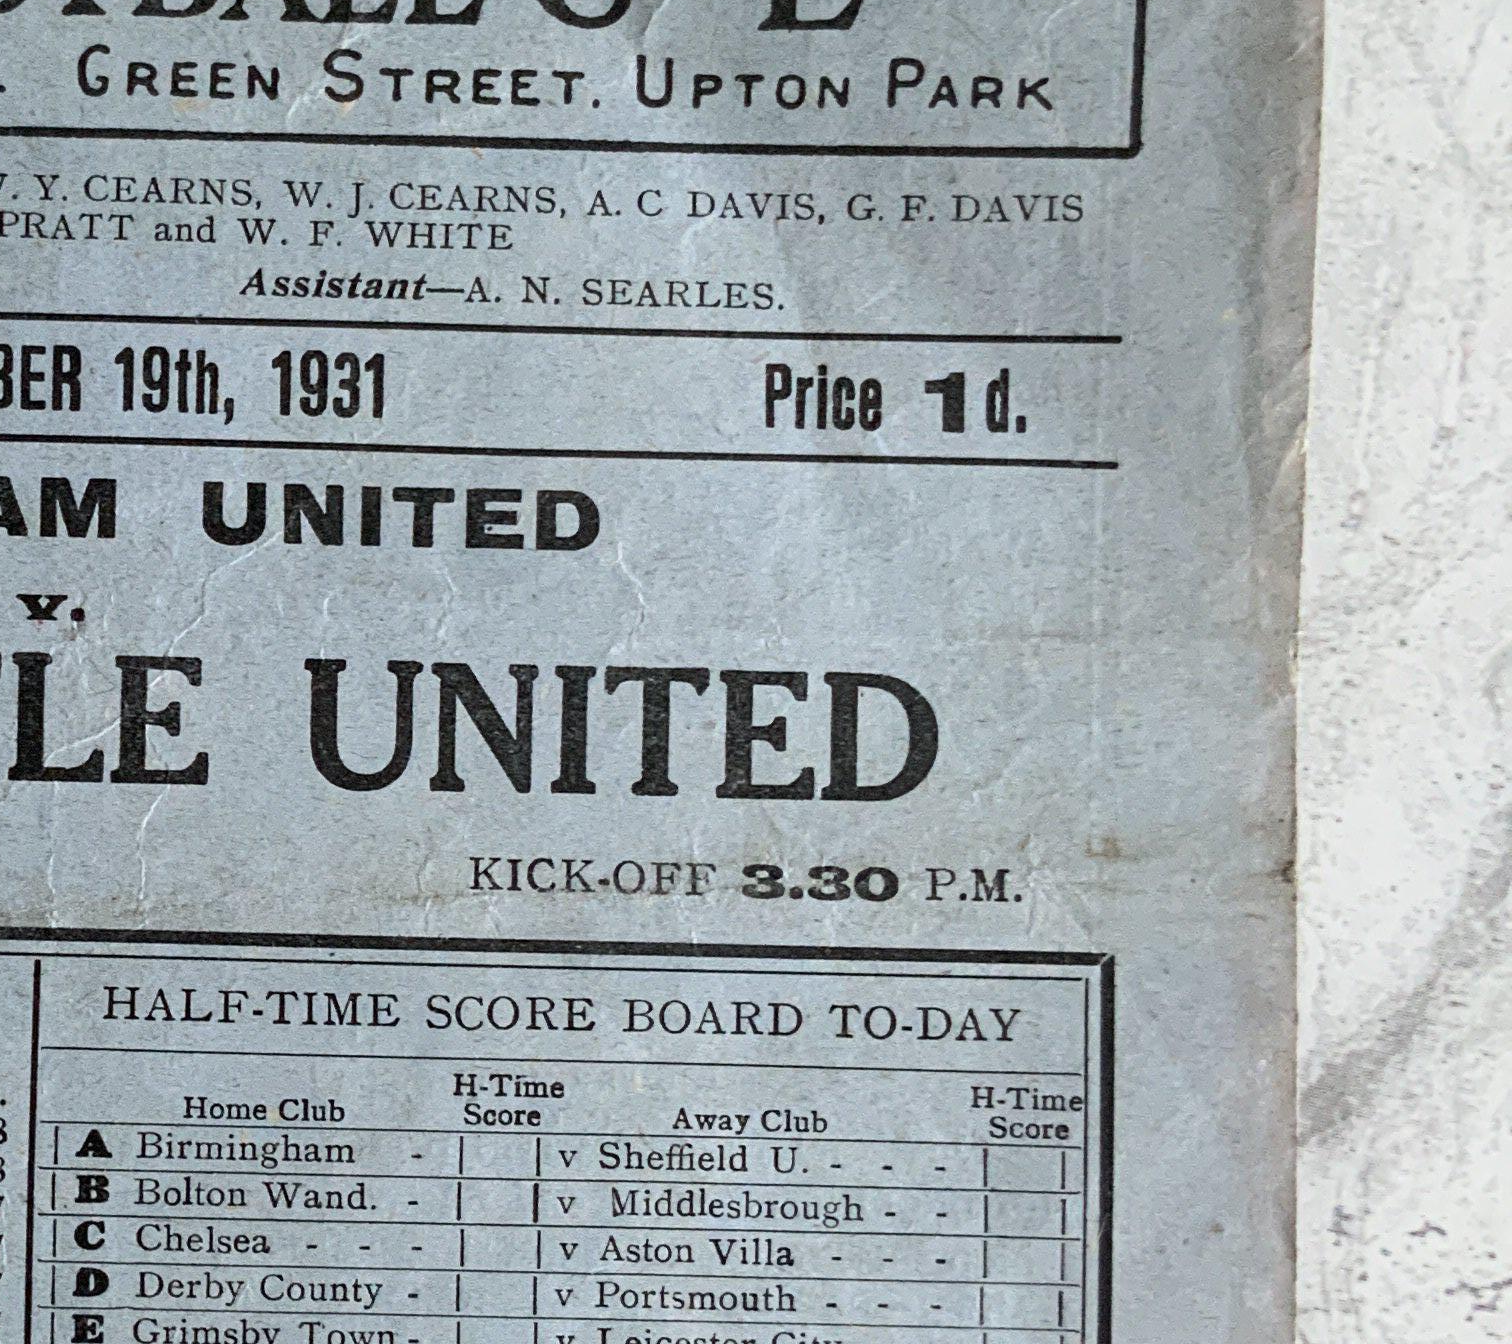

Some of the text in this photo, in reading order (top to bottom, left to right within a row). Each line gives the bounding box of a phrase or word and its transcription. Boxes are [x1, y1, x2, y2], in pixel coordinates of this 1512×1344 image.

[32, 173, 68, 202] Y.
[83, 174, 262, 211] CEARNS,
[282, 179, 333, 209] W.
[347, 181, 374, 219] J.
[388, 181, 567, 219] CEARNS,
[586, 189, 622, 217] A.
[636, 189, 664, 218] C
[686, 190, 826, 226] DAVIS,
[846, 193, 884, 222] G.
[900, 194, 935, 222] F.
[951, 193, 1084, 223] DAVIS
[153, 214, 217, 244] and
[236, 217, 288, 246] W.
[308, 219, 342, 247] F.
[363, 220, 514, 251] WHITE
[521, 275, 561, 306] N.
[582, 278, 785, 311] SEARLES.
[113, 345, 235, 426] 19th,
[271, 349, 386, 420] 1931
[764, 362, 883, 432] Price
[201, 480, 601, 552] UNITED
[303, 657, 940, 803] UNITED
[468, 856, 1023, 903] KICK-OFF 3.30 P.M.
[102, 985, 1022, 1042] HALF-TIME SCORE BOARD TO-DAY
[452, 1072, 565, 1099] H-Time
[970, 1085, 1084, 1113] H-Time
[182, 1095, 346, 1123] Home Club
[672, 1107, 828, 1136] Away Club
[74, 1128, 356, 1170] A Birmingham
[598, 1141, 809, 1174] Sheffield U.
[71, 1266, 384, 1311] D Derby County
[594, 1280, 797, 1313] Portsmouth
